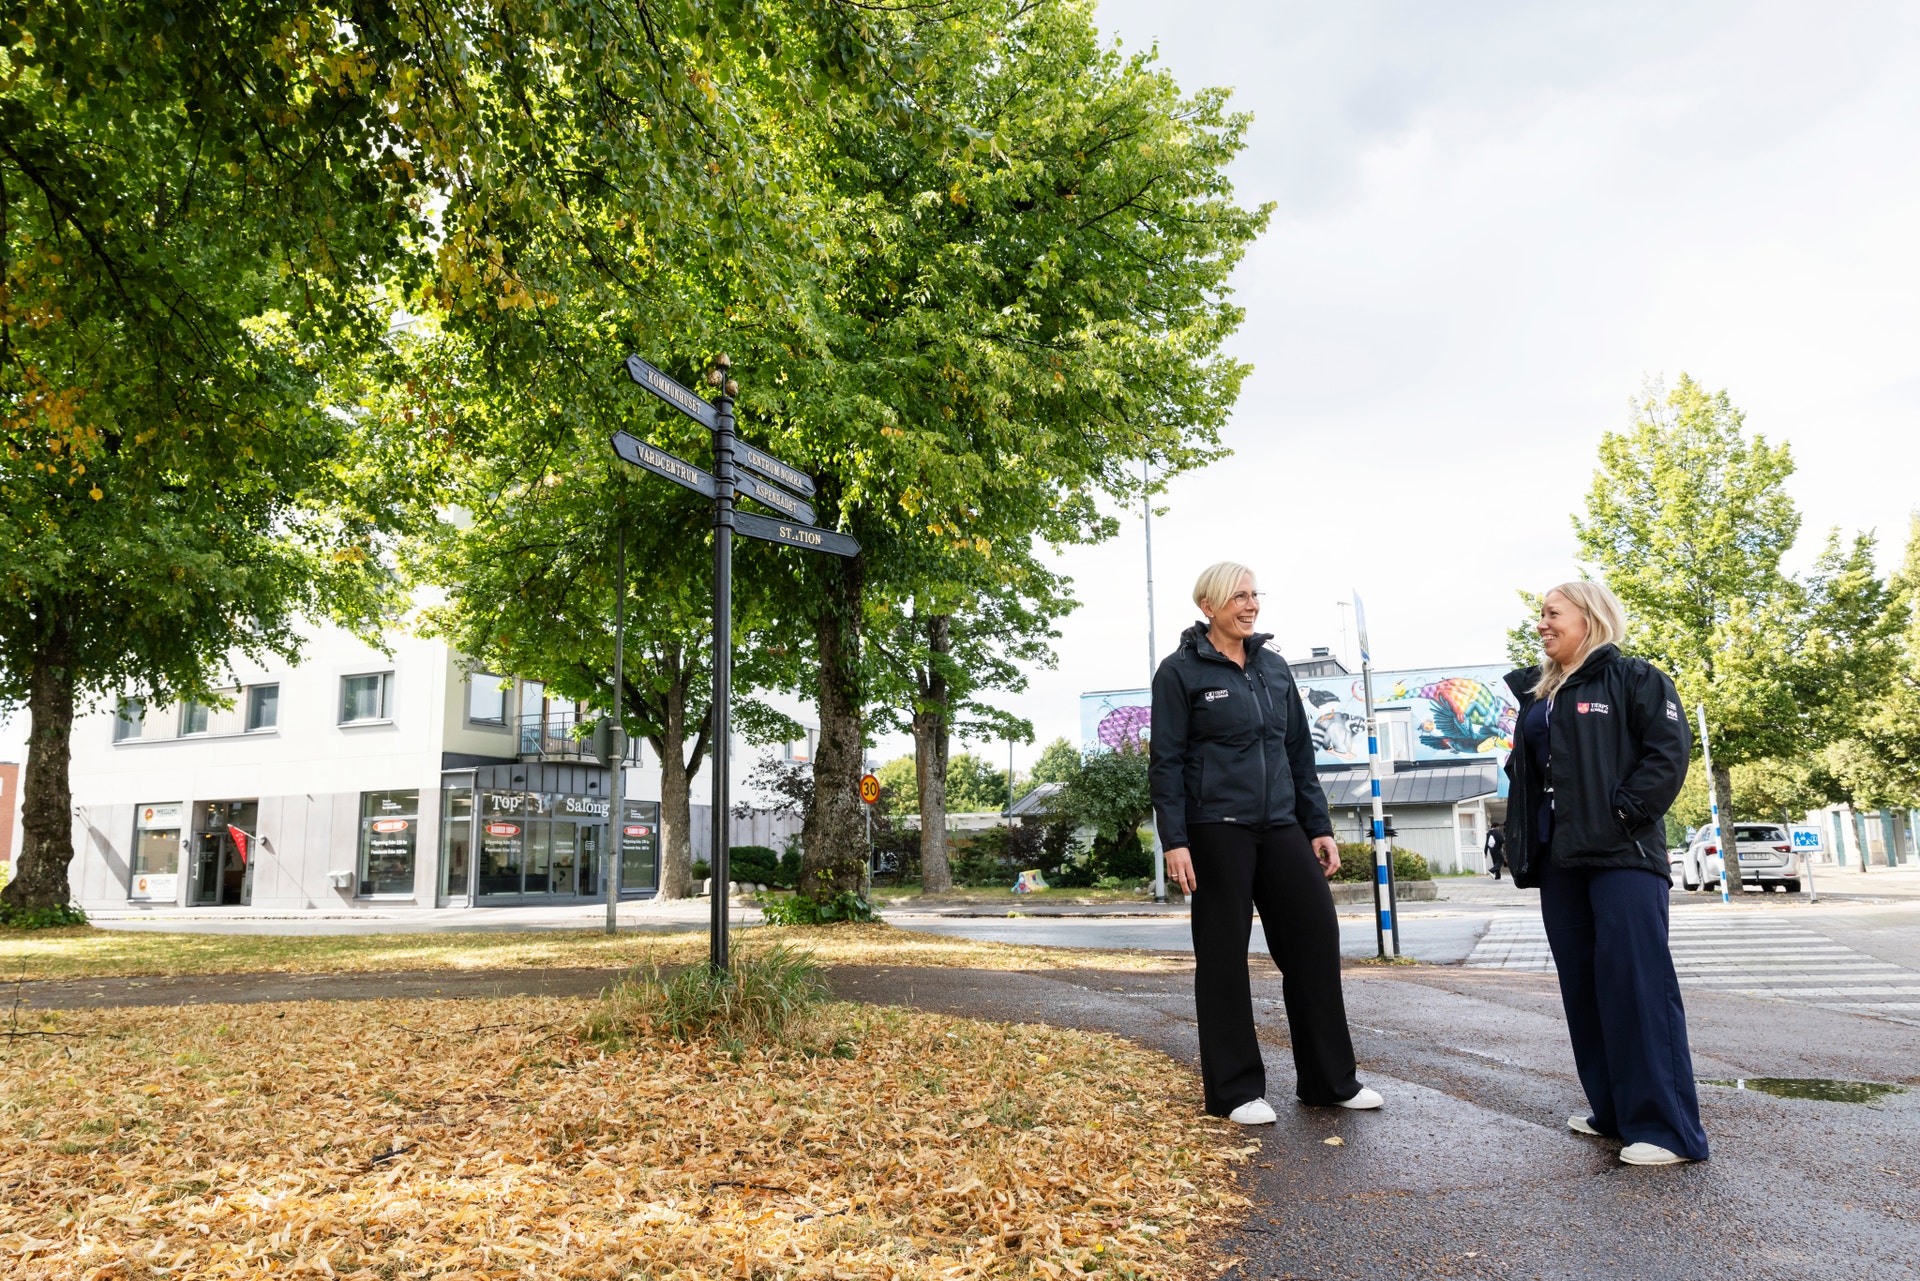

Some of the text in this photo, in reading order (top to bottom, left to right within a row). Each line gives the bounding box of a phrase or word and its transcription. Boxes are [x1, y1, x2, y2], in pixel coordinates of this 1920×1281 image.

[648, 370, 701, 414] KOMMUNHUSET
[748, 451, 802, 488] CENTRUM NORRA
[755, 484, 797, 514] ASPENBADET
[863, 781, 877, 796] 30
[492, 794, 518, 813] Top
[566, 797, 610, 818] Salong
